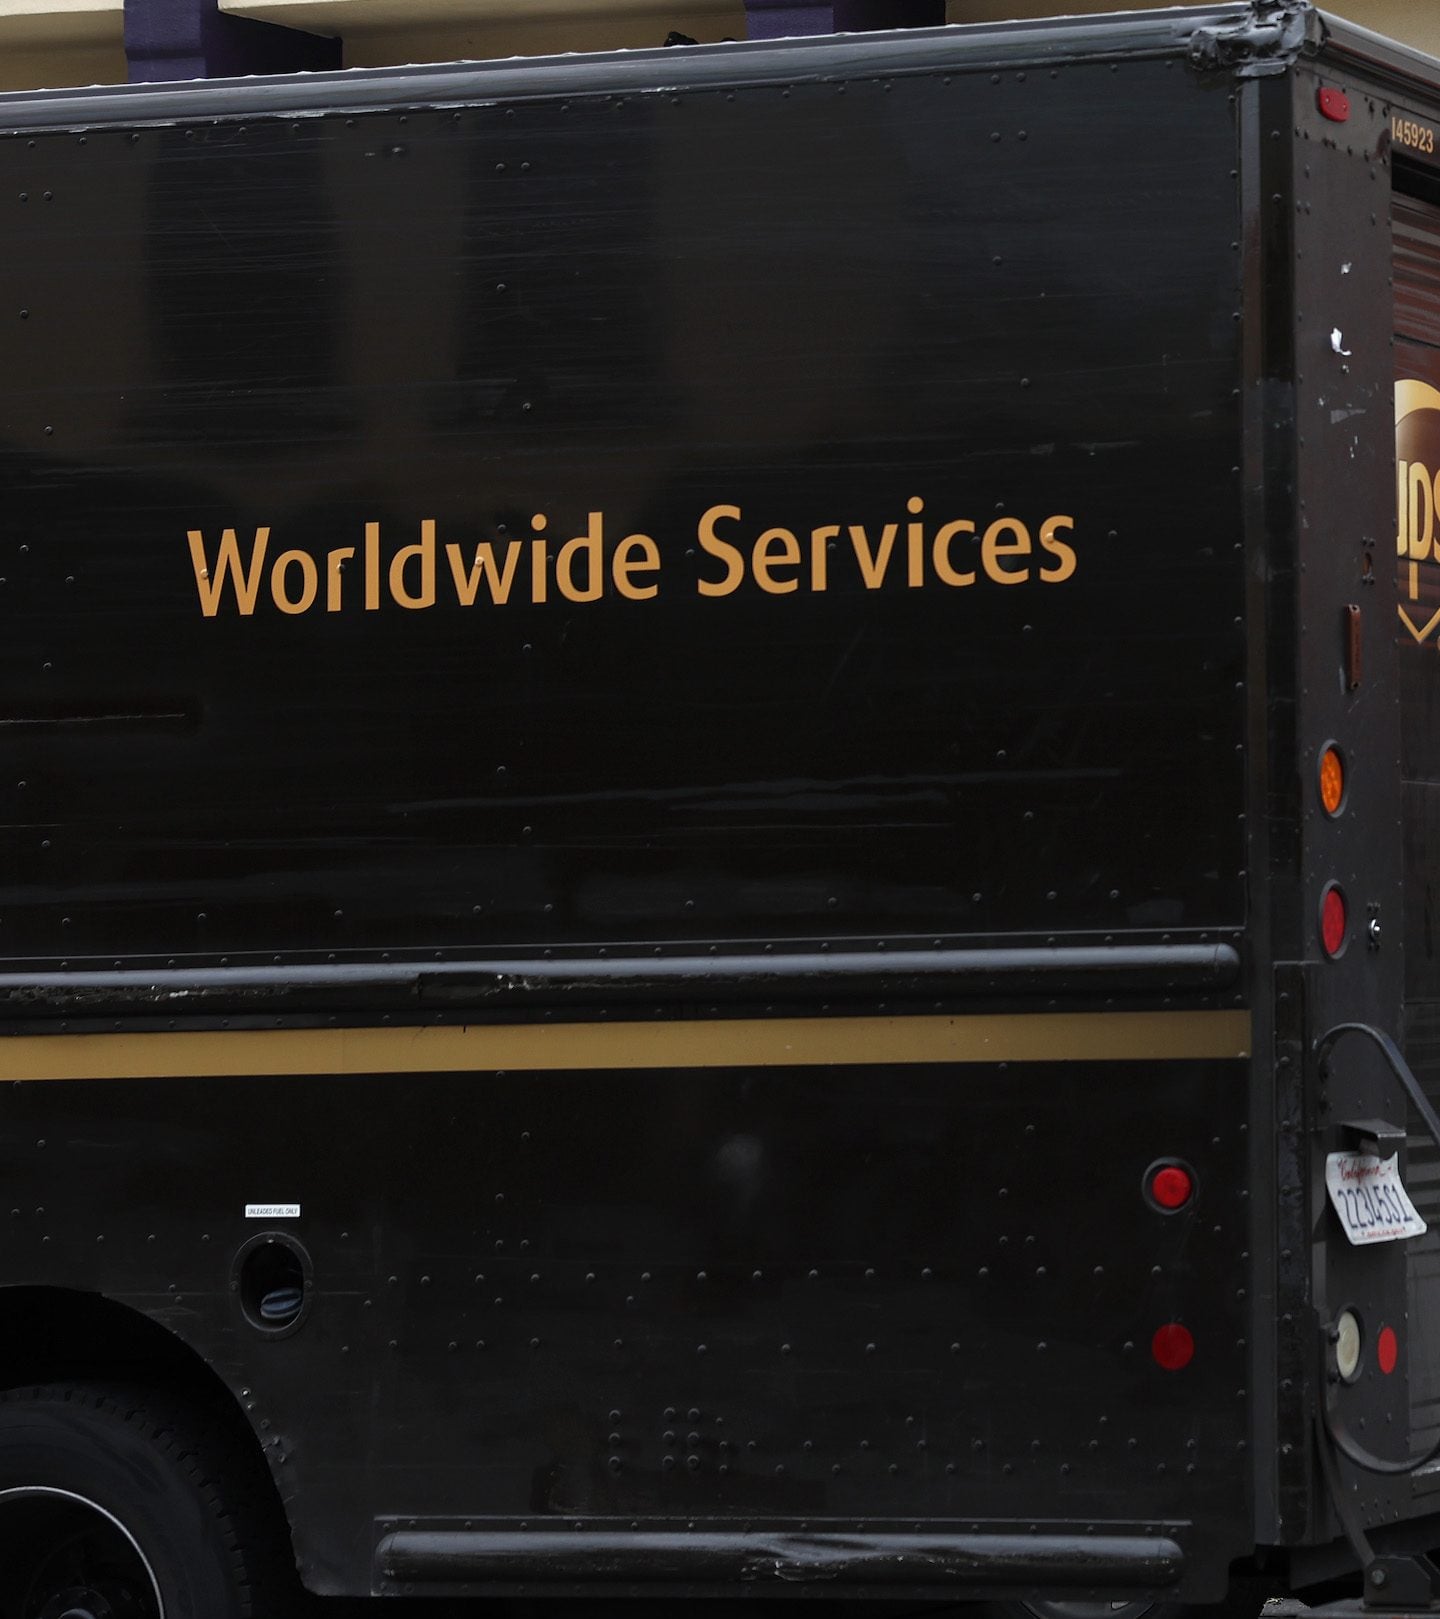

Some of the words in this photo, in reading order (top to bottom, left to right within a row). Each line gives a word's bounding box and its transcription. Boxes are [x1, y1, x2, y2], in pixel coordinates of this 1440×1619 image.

[1391, 116, 1434, 153] 145923
[187, 511, 661, 617] Worldwide
[698, 495, 1077, 597] Services
